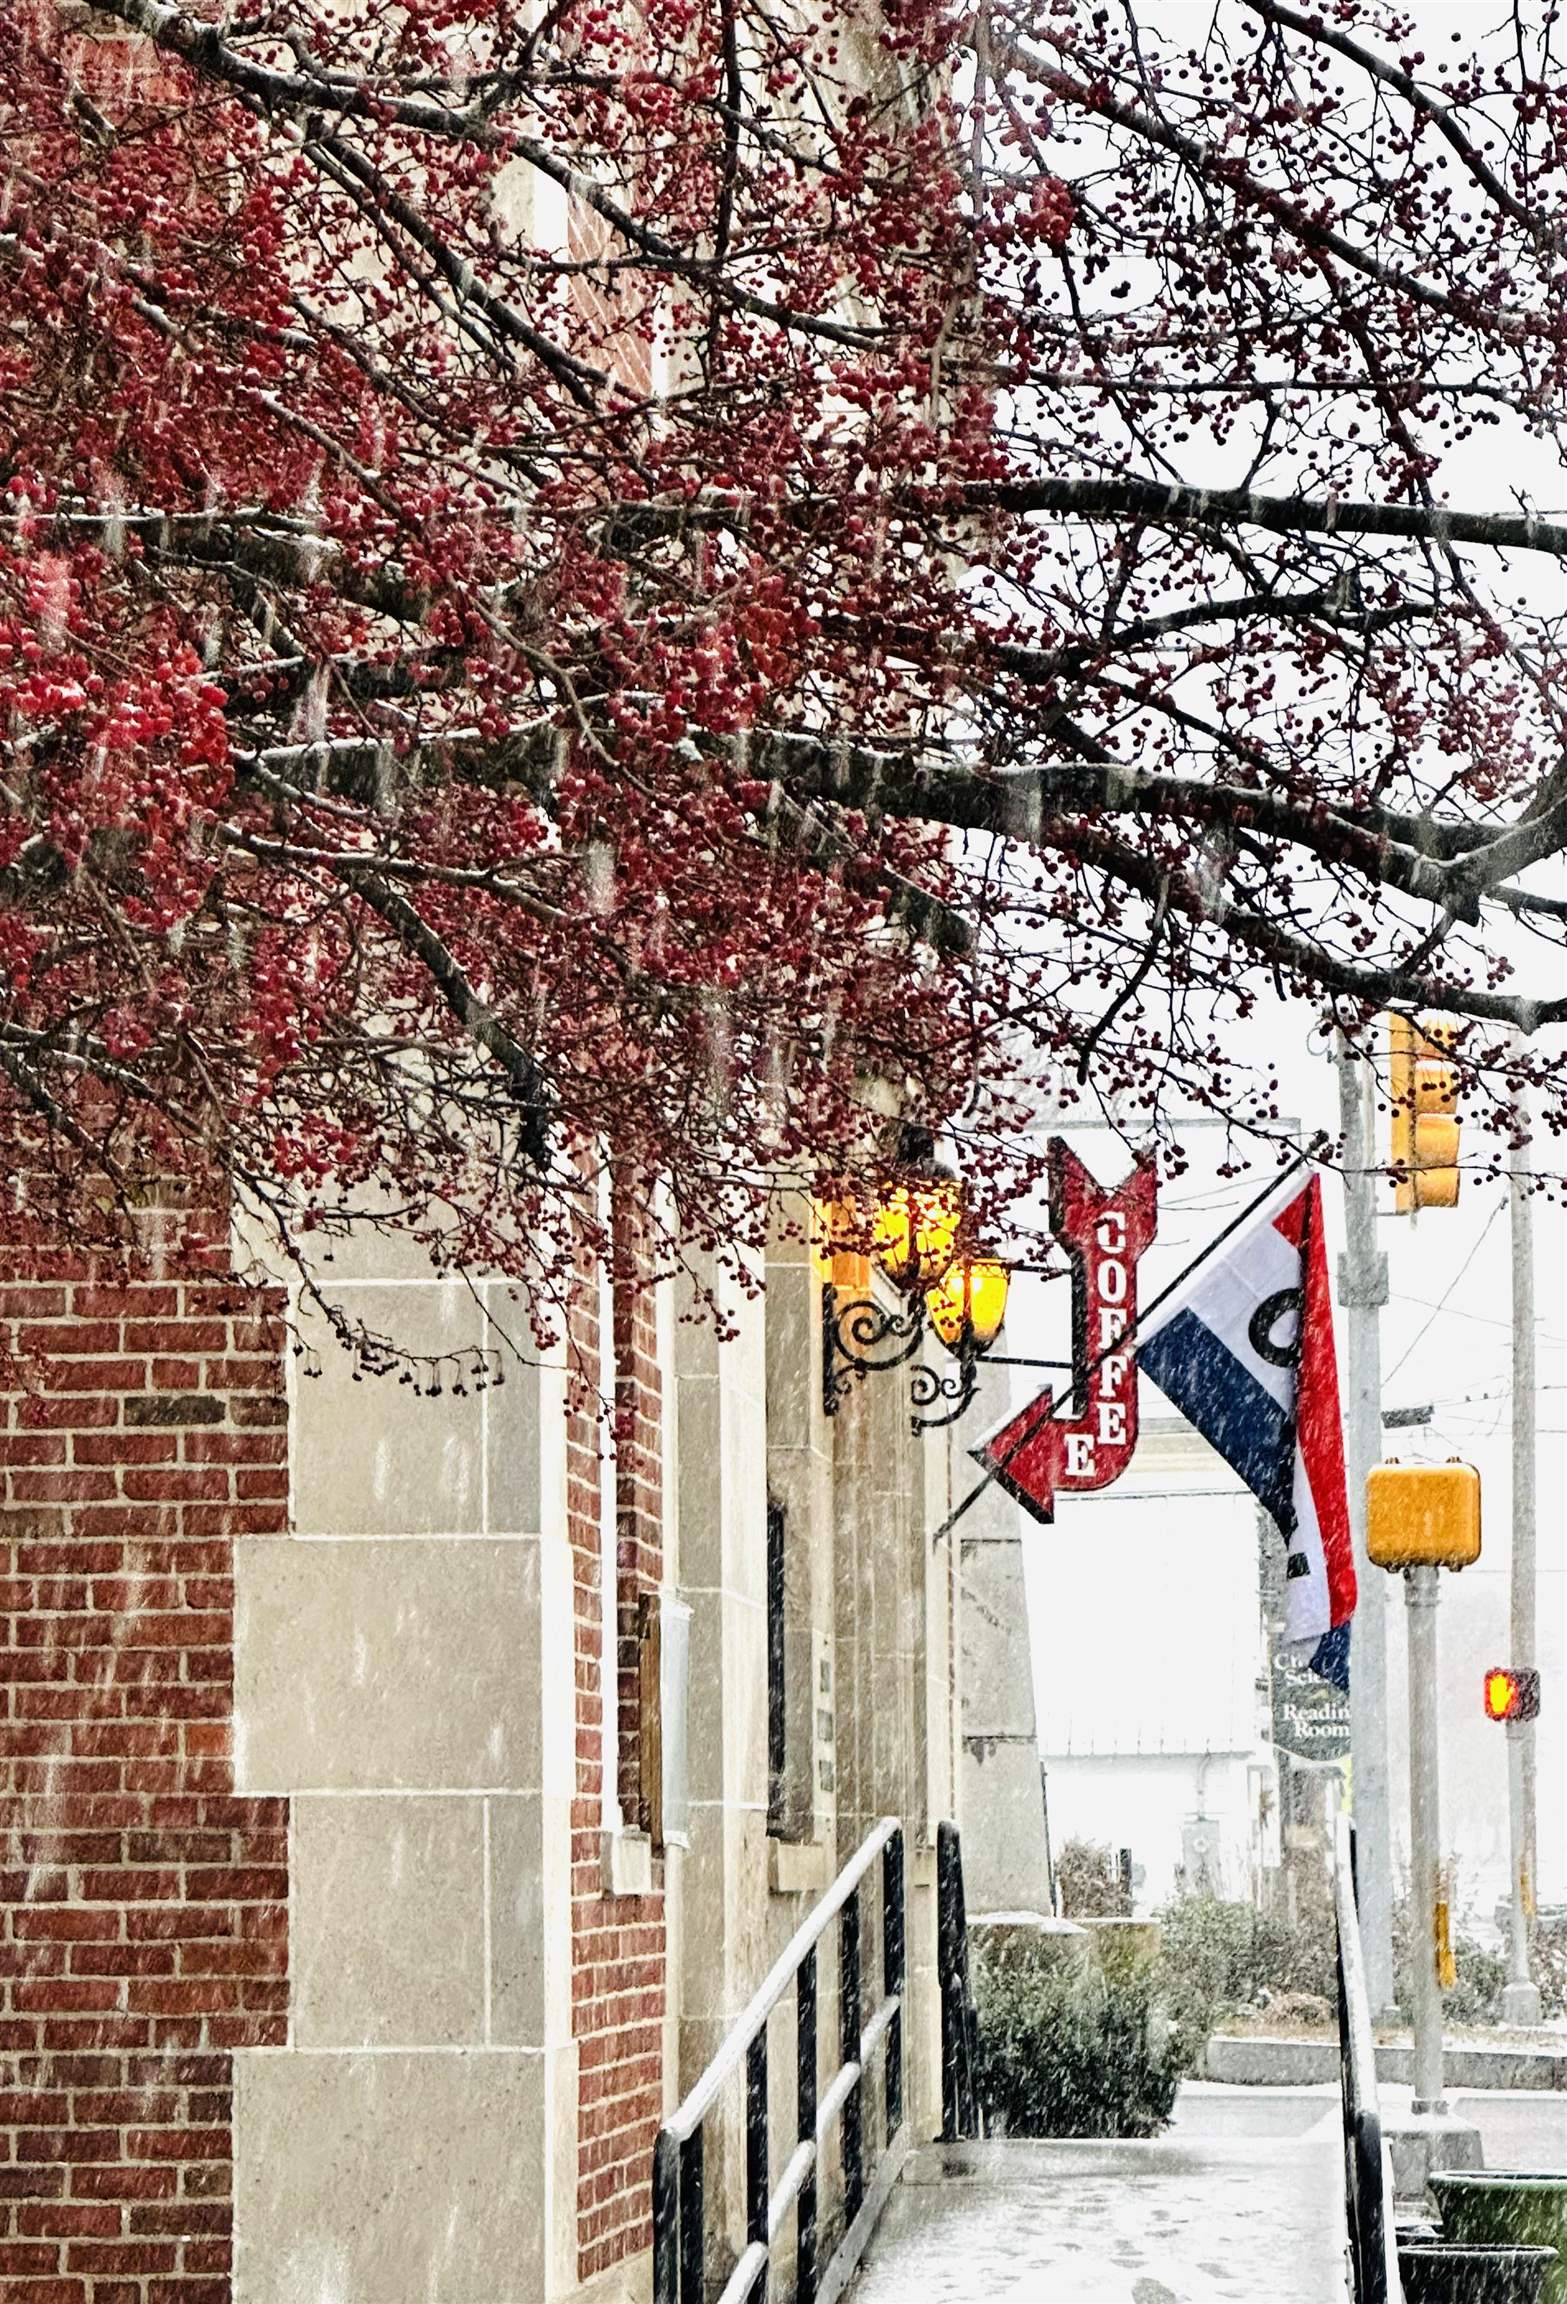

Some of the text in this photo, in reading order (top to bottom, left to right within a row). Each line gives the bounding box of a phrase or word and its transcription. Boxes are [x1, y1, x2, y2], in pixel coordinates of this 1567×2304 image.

[1064, 1210, 1128, 1477] COFFEE
[1283, 1702, 1351, 1720] Readin
[1294, 1720, 1350, 1738] Room
